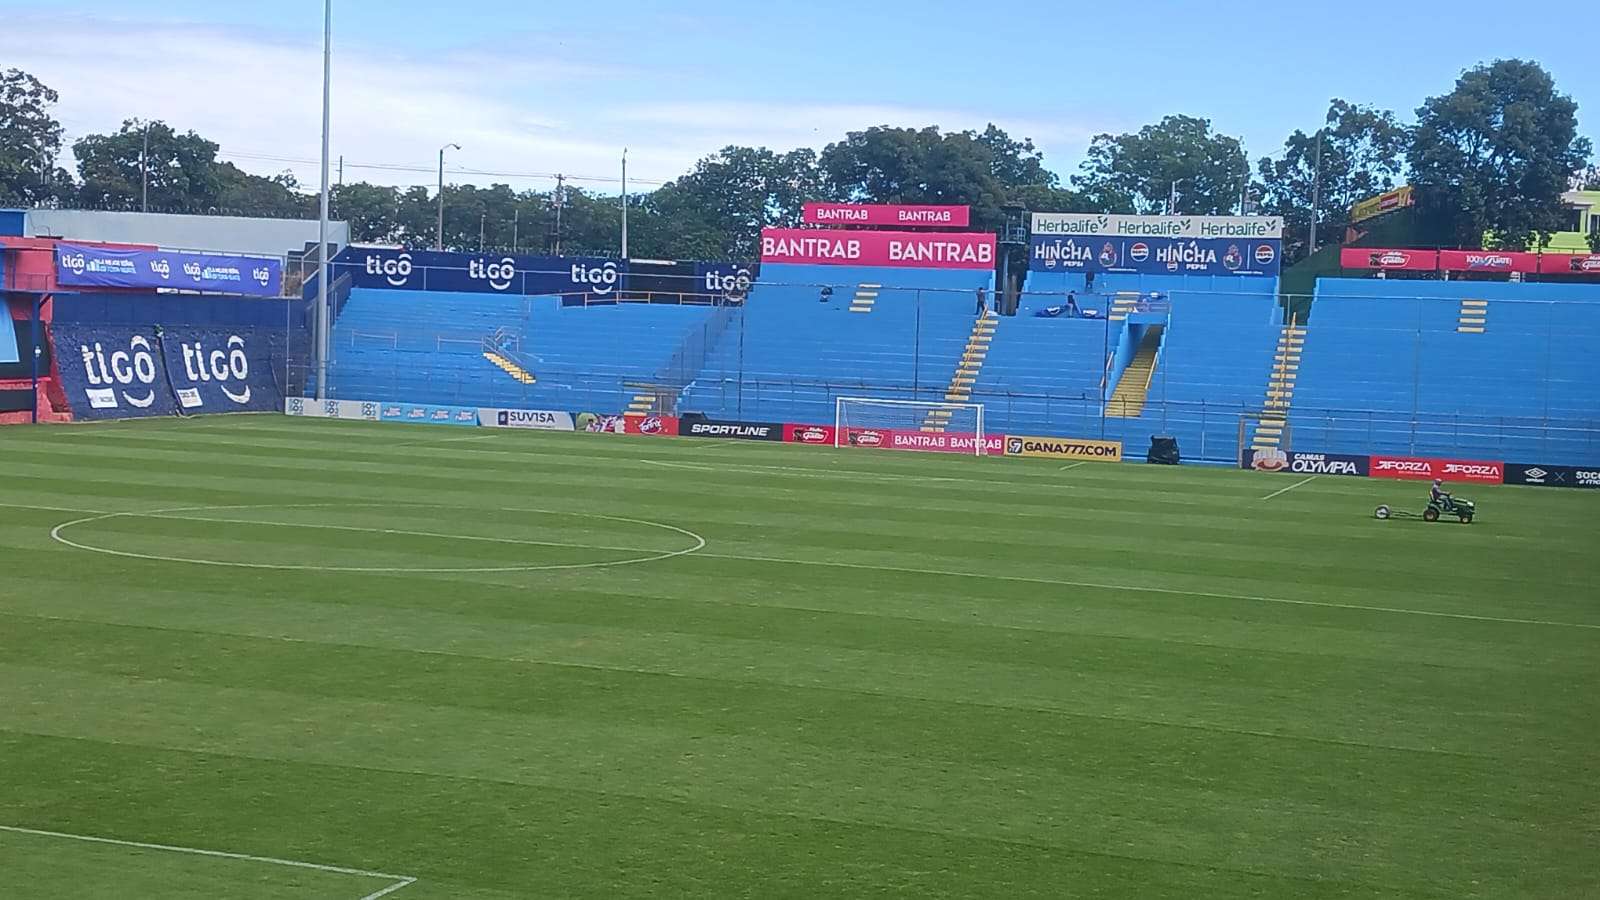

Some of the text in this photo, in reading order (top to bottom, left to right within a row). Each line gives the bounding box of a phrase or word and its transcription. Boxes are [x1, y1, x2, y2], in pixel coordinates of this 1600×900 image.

[817, 208, 951, 222] BANTRAB BANTRAB
[1037, 219, 1098, 233] Herbalife
[1118, 221, 1181, 235] Herbalife
[1200, 222, 1266, 236] Herbalife
[762, 238, 992, 262] BANTRAB BANTRAB
[62, 254, 85, 275] tigo
[150, 260, 170, 279] tigo
[183, 263, 200, 281] tigo
[367, 254, 412, 285] tigo
[469, 257, 514, 290] tigo
[253, 267, 270, 286] tigo
[571, 261, 617, 294] tigo
[706, 269, 750, 302] tigo
[81, 336, 155, 408] tigo
[182, 336, 250, 404] tigo
[510, 411, 555, 423] SUVISA
[691, 423, 769, 436] SPORTLINE
[895, 435, 1002, 449] BANTRAB BANTRAB
[1024, 441, 1117, 457] GANA777.COM
[1575, 471, 1600, 480] SOC
